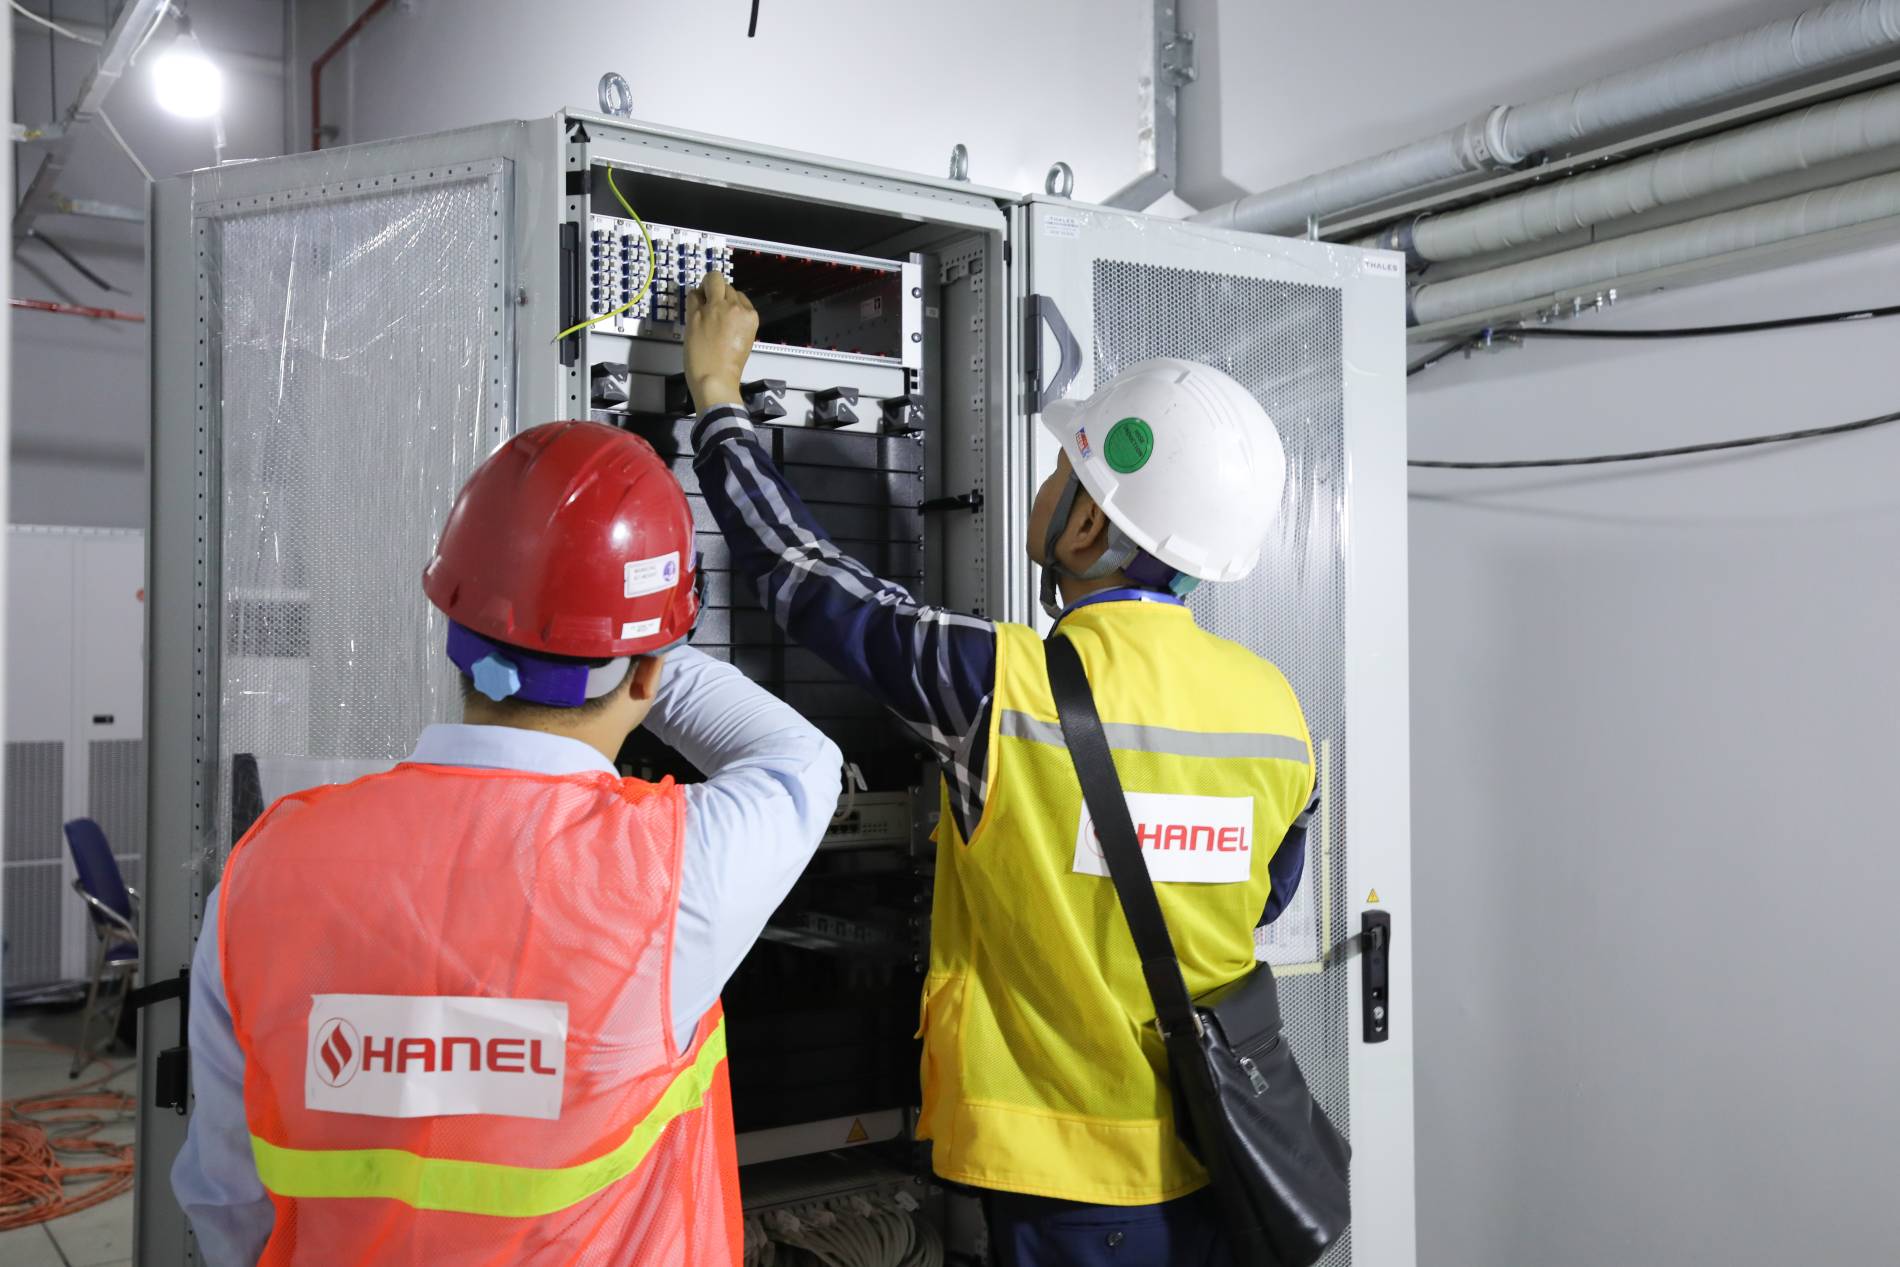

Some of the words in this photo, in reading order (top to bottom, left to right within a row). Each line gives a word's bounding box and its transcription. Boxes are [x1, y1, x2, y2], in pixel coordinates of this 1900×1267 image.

[1365, 261, 1398, 271] THALES
[1137, 823, 1249, 852] HANEL
[362, 1036, 556, 1075] HANEL
